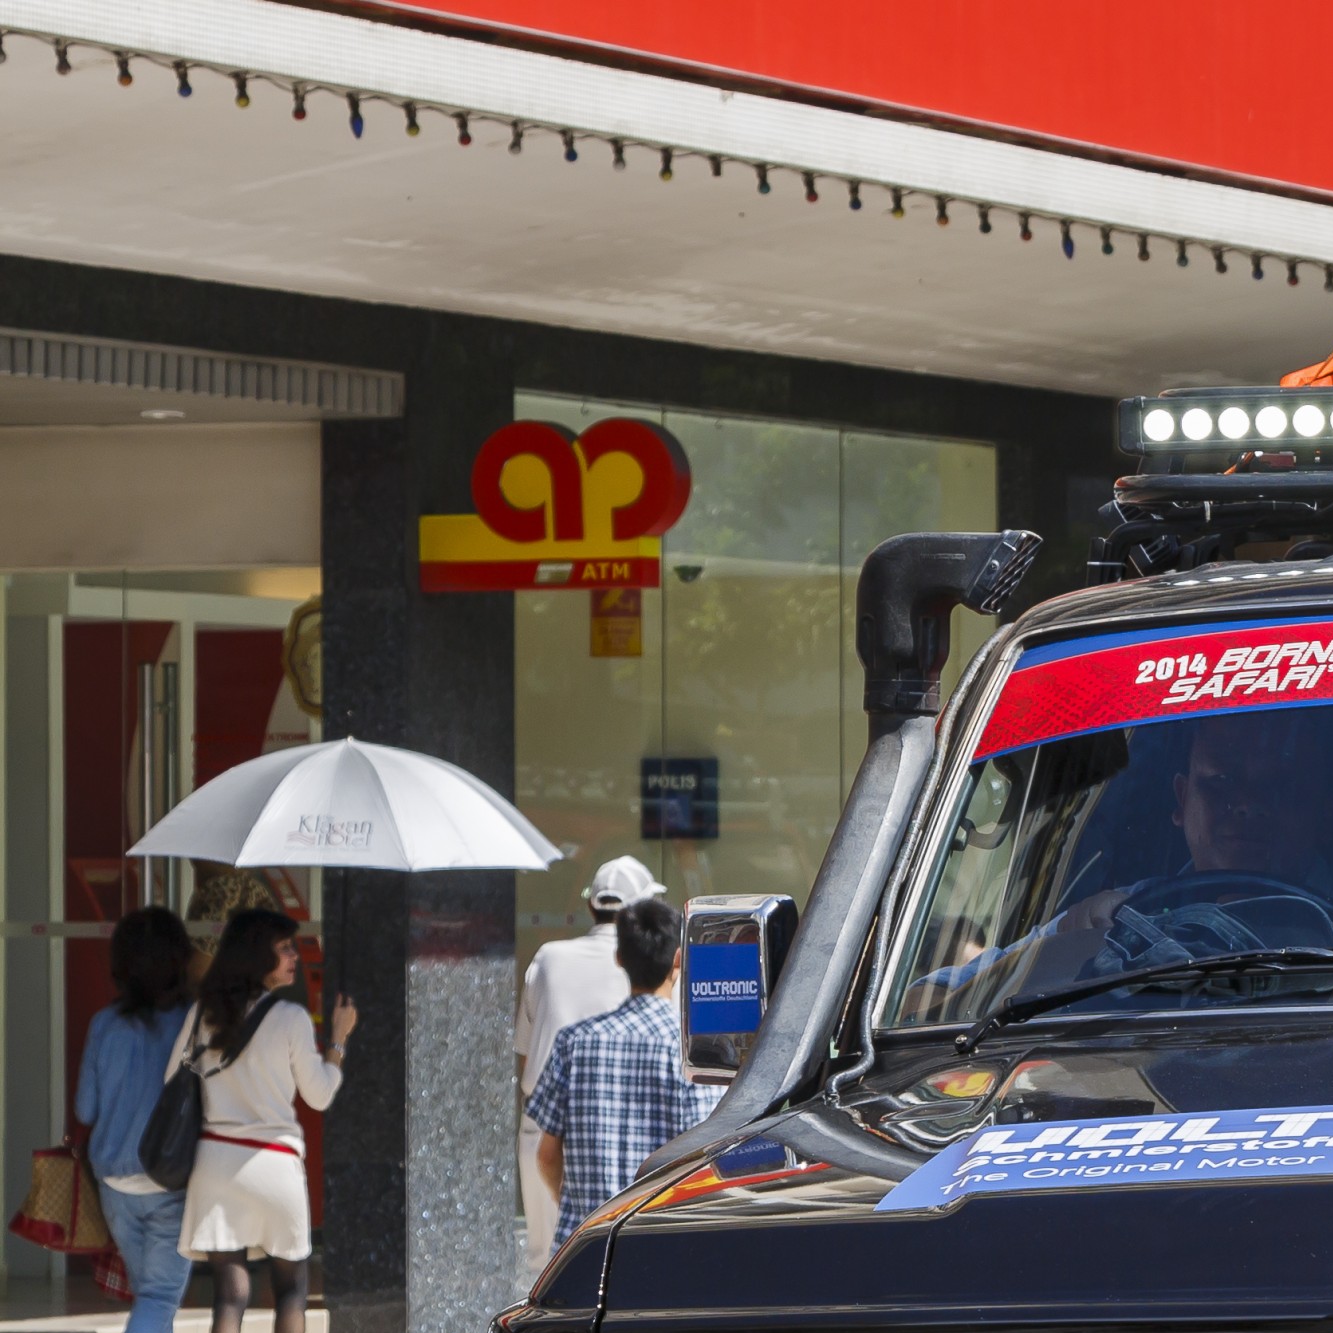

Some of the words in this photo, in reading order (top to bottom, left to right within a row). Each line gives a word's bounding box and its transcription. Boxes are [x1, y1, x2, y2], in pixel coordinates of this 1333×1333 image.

[582, 563, 629, 579] ATM
[1135, 653, 1207, 684] 2014
[1161, 664, 1327, 704] SAFARI
[649, 775, 696, 790] POLIS
[691, 980, 758, 996] VOLTRONIC
[940, 1172, 1005, 1197] The
[1023, 1159, 1183, 1179] Original
[1197, 1155, 1326, 1170] Motor
